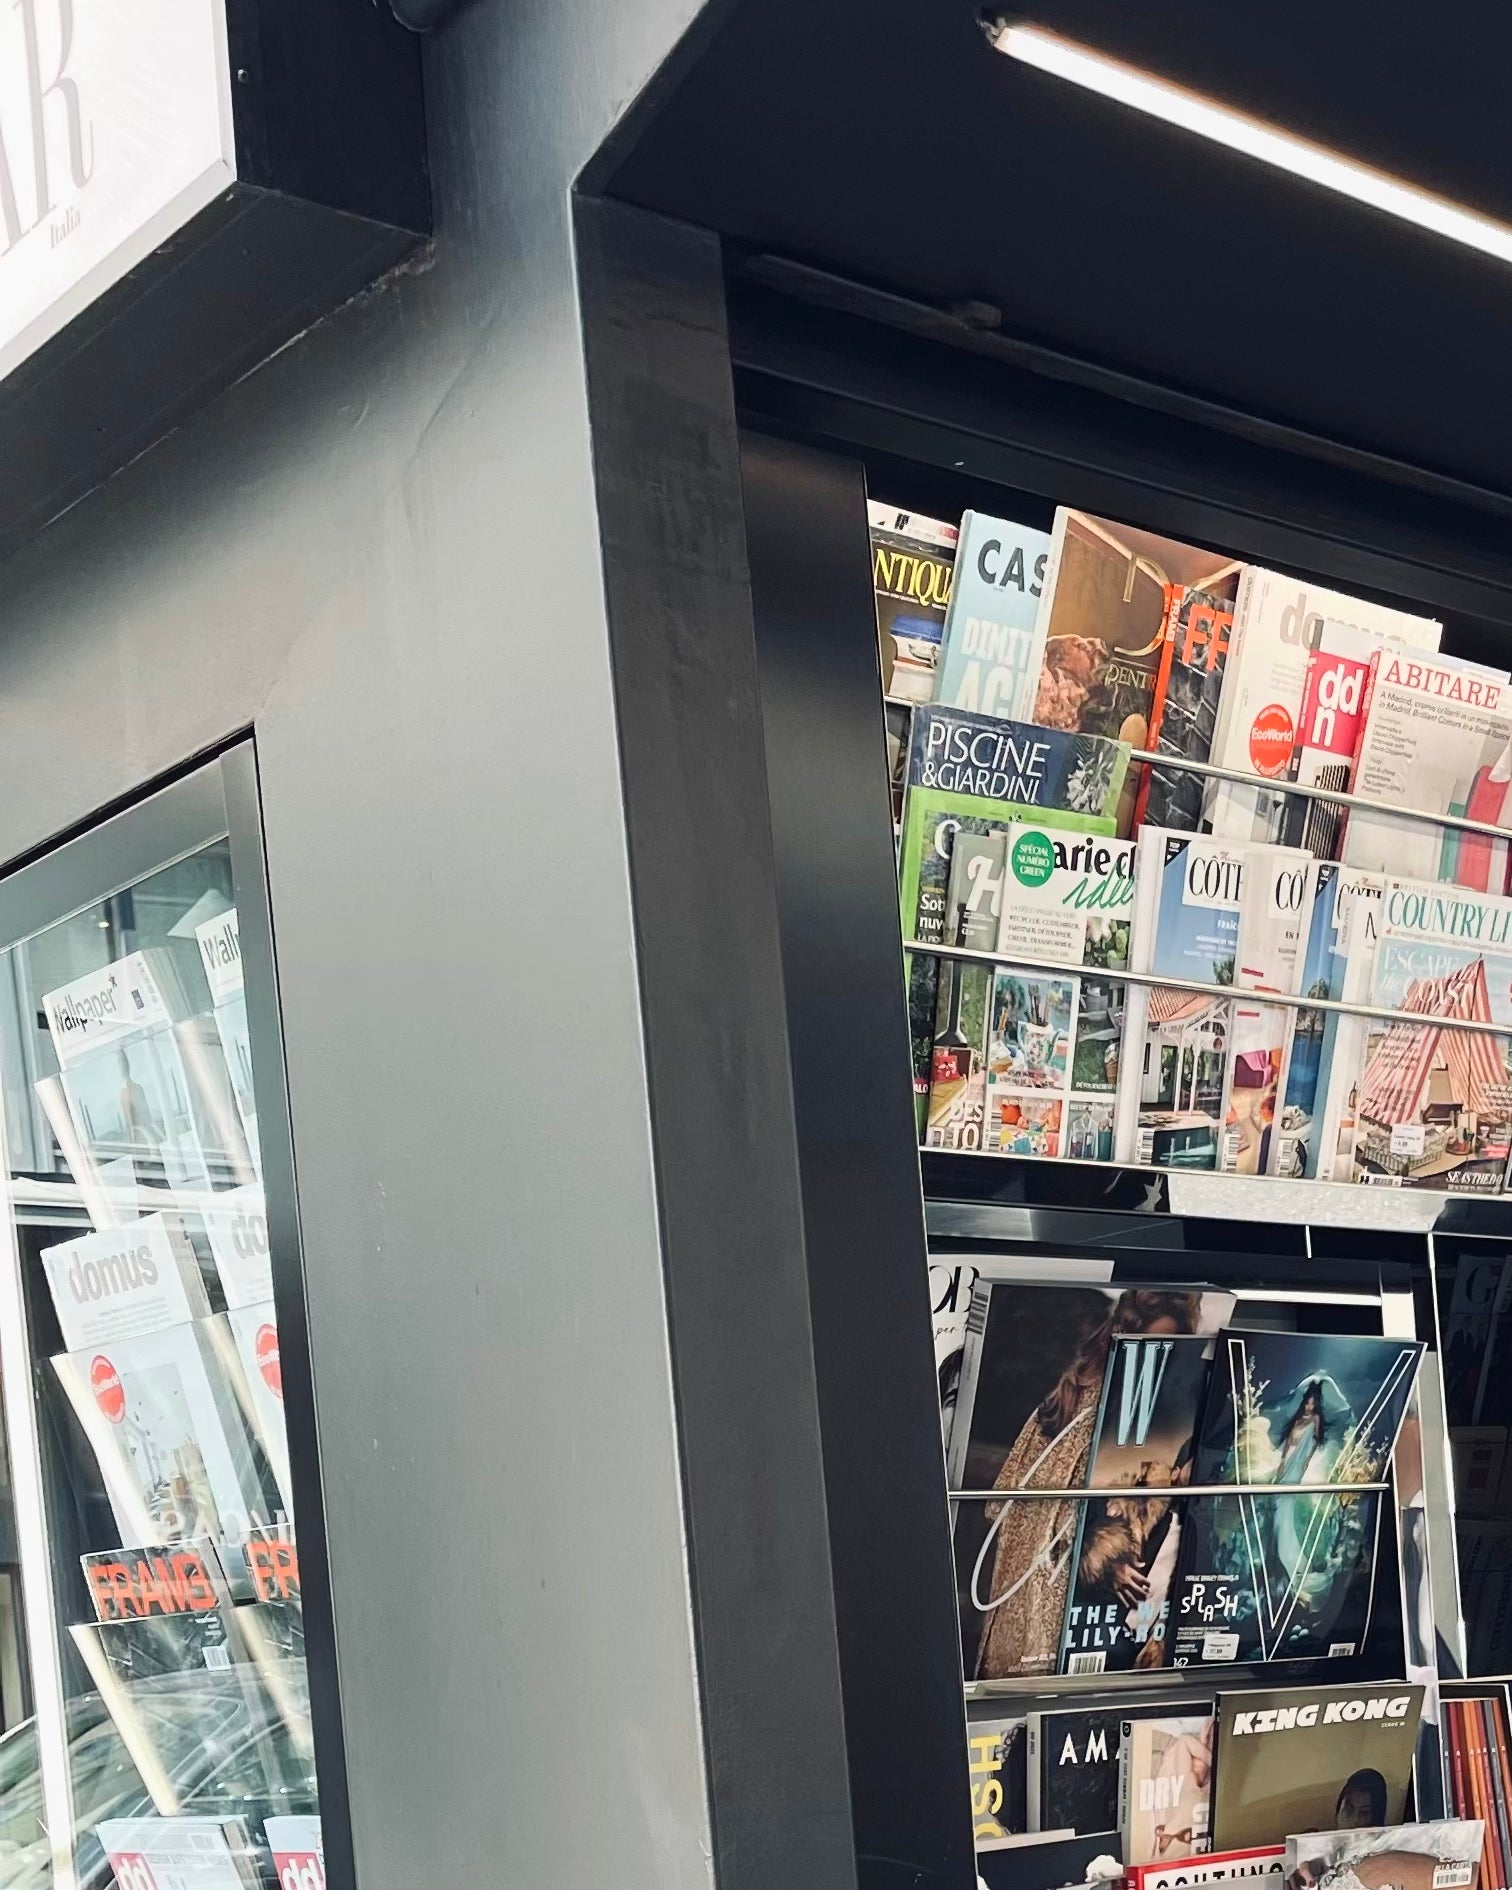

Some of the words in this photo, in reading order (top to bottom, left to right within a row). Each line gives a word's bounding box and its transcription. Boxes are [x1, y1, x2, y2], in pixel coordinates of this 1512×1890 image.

[49, 205, 81, 250] Italia
[1318, 663, 1362, 716] dd
[1384, 659, 1501, 710] ABITARE
[928, 720, 1051, 778] PISCINE
[921, 761, 1040, 805] &GIARDINI
[1016, 853, 1050, 867] NUMÉRO
[1019, 843, 1049, 857] SPÉCIAL
[1388, 890, 1491, 940] COUNTRY
[69, 1243, 159, 1306] domus
[1115, 1341, 1174, 1447] W
[1227, 1338, 1416, 1662] V
[1071, 1604, 1118, 1626] THE
[1180, 1583, 1239, 1622] SPLASH
[1232, 1703, 1320, 1737] KING
[1322, 1695, 1412, 1725] KONG
[1059, 1728, 1120, 1767] AM
[1139, 1775, 1184, 1812] DRY
